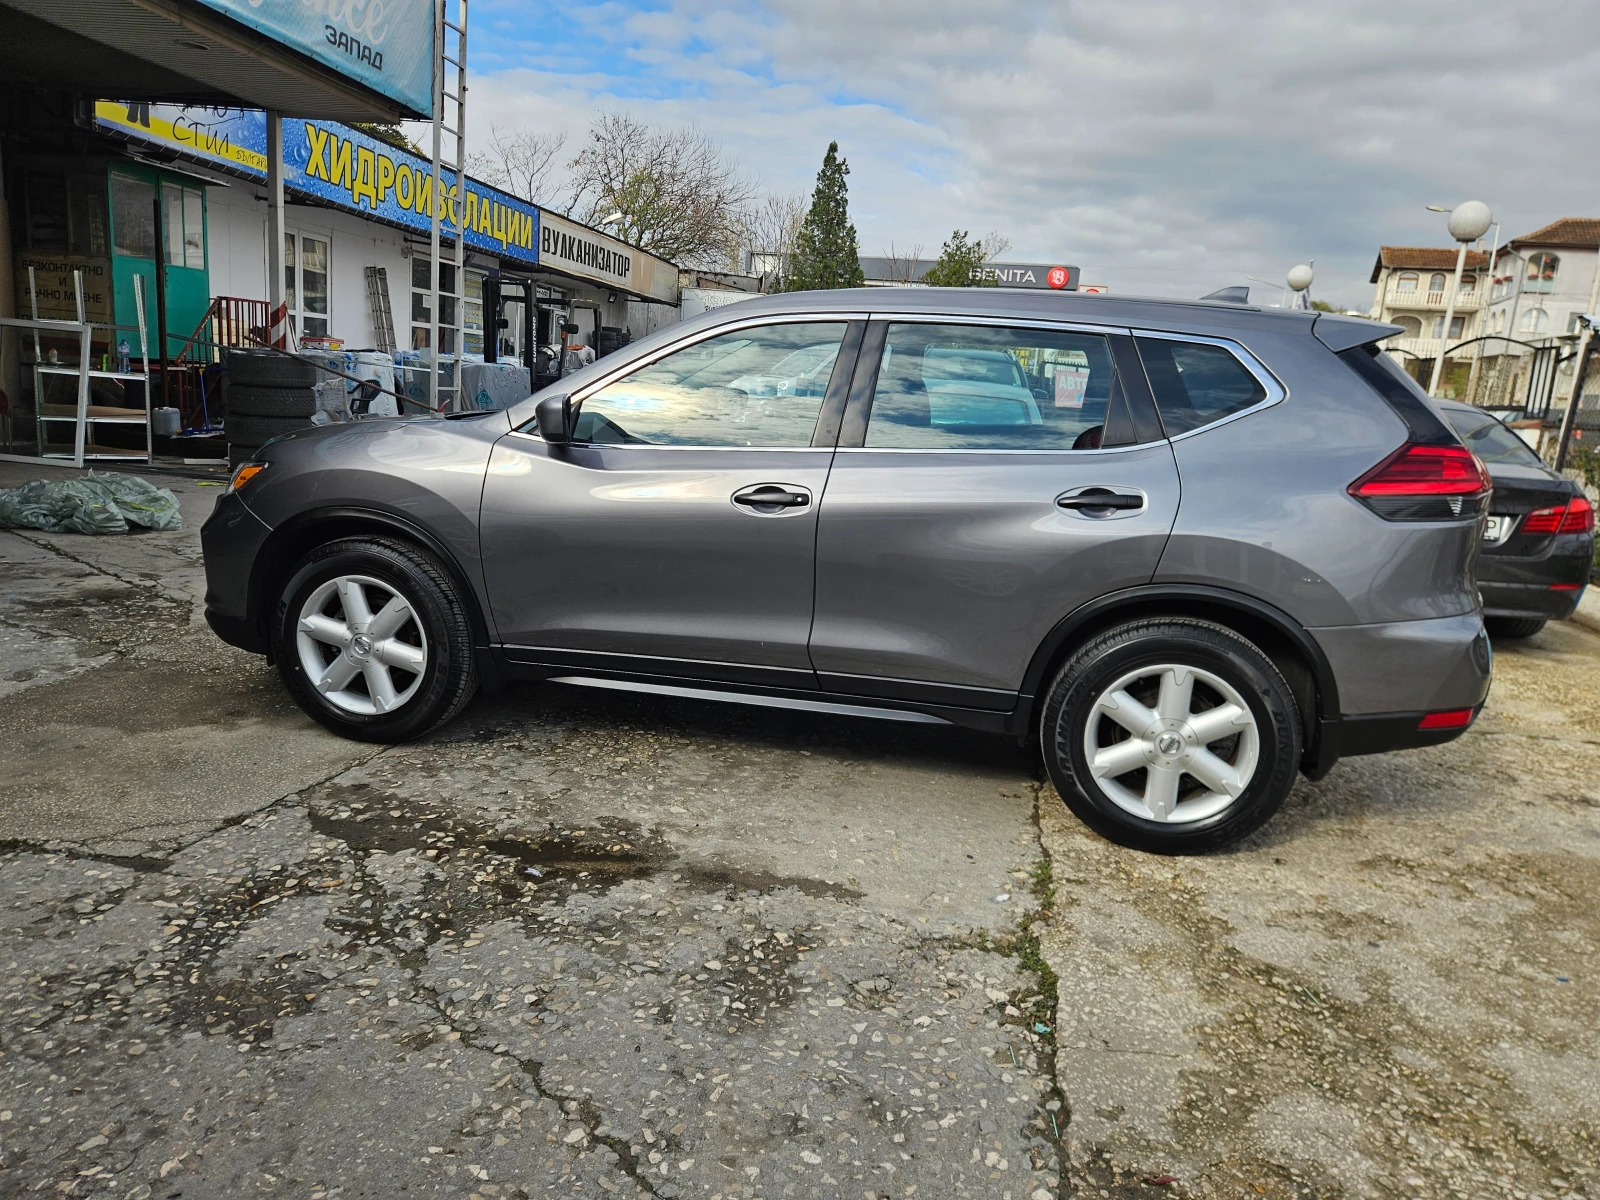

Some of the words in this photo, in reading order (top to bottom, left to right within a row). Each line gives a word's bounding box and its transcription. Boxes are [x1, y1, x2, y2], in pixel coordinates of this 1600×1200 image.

[325, 24, 383, 71] ЗАПАД
[542, 226, 631, 278] ВУЛКАНИЗАТОР
[64, 291, 102, 303] МЕНЕ
